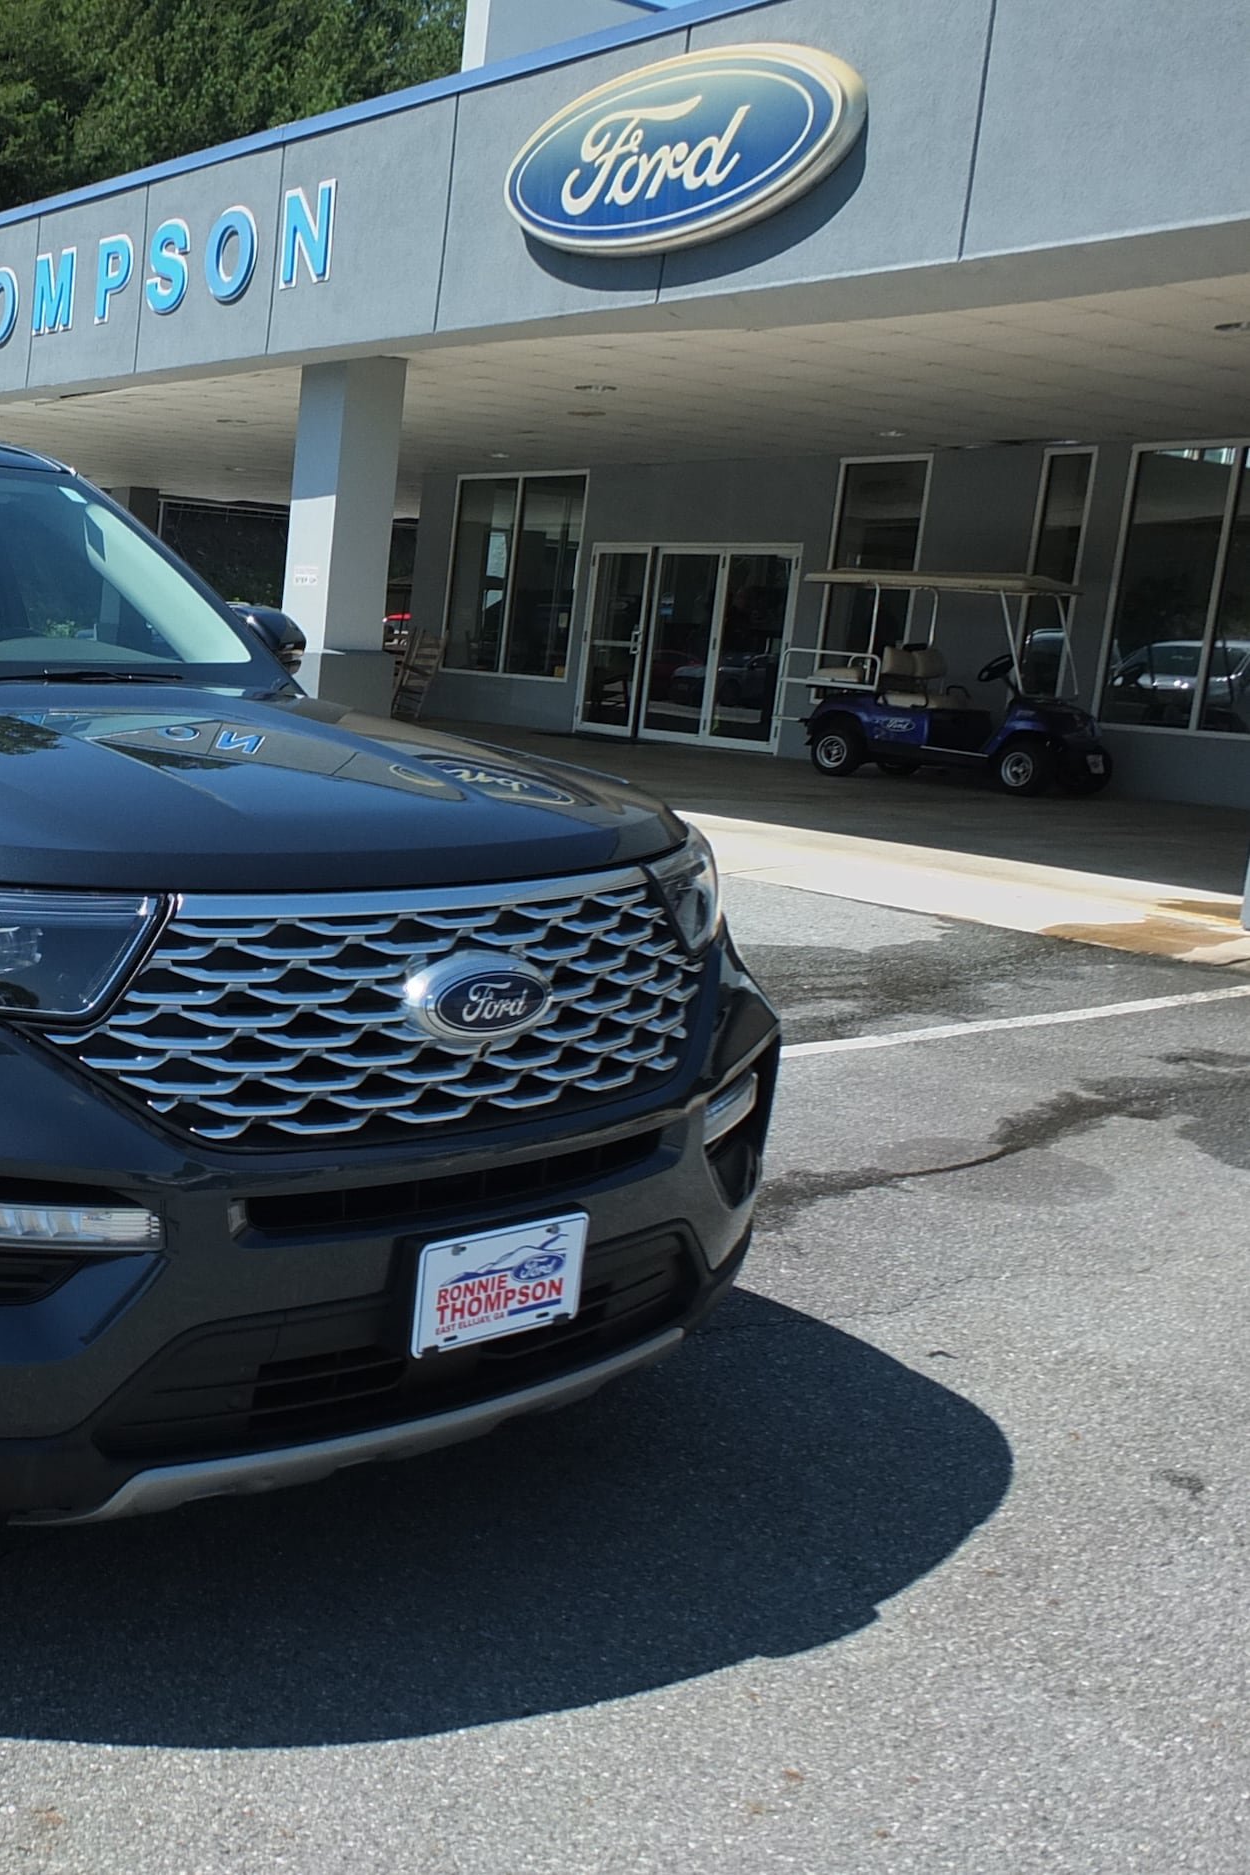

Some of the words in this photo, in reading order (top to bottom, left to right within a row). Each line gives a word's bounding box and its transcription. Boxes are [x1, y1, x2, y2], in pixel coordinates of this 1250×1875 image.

[560, 94, 751, 216] Ford
[461, 981, 529, 1023] Ford
[519, 1256, 558, 1280] Ford
[436, 1277, 564, 1326] THOMPSON
[437, 1274, 508, 1305] RONNIE
[435, 1323, 457, 1336] EAST
